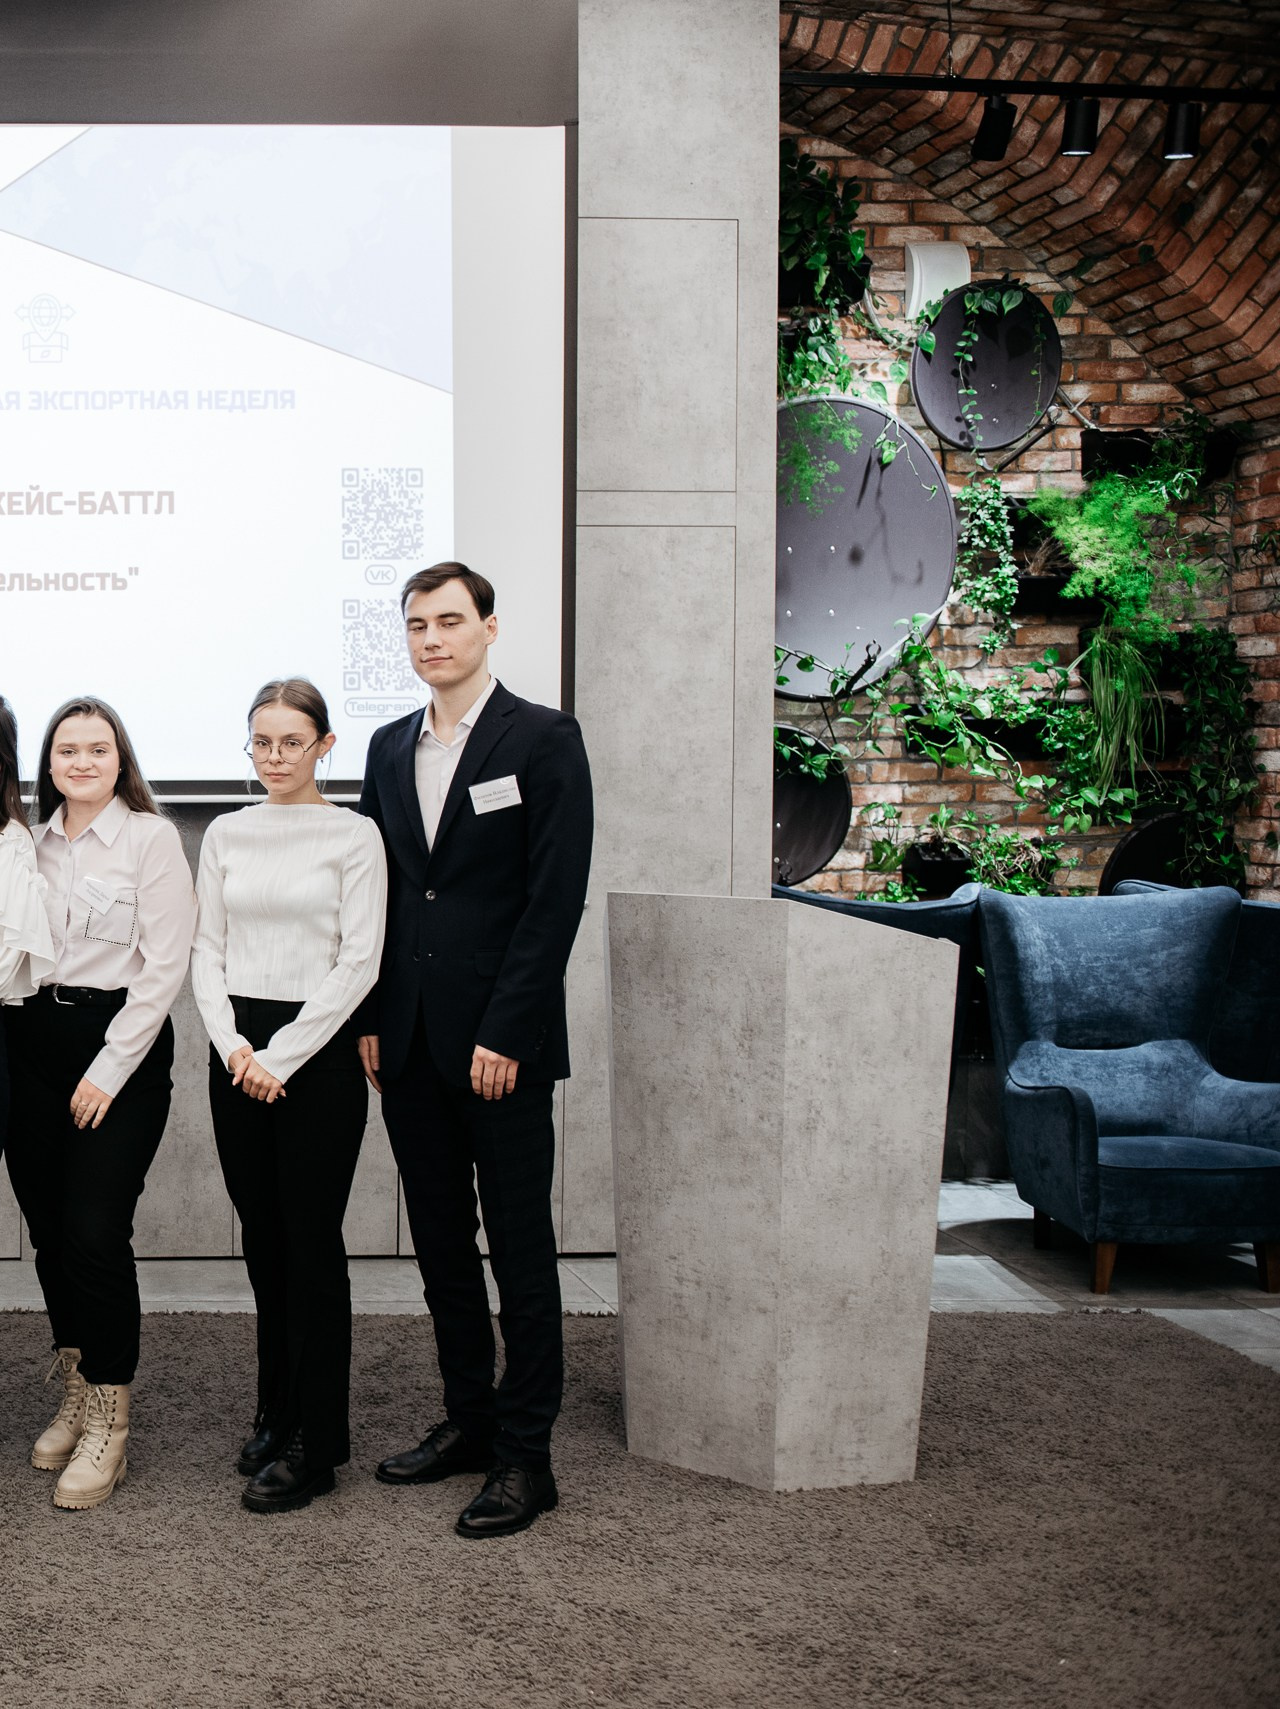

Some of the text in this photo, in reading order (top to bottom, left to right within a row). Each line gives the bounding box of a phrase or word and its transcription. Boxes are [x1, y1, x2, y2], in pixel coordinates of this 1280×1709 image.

[28, 389, 189, 411] ЭКСПОРТНАЯ
[196, 389, 296, 414] НЕДЕЛЯ
[369, 570, 392, 581] VK
[348, 700, 416, 715] Telegram
